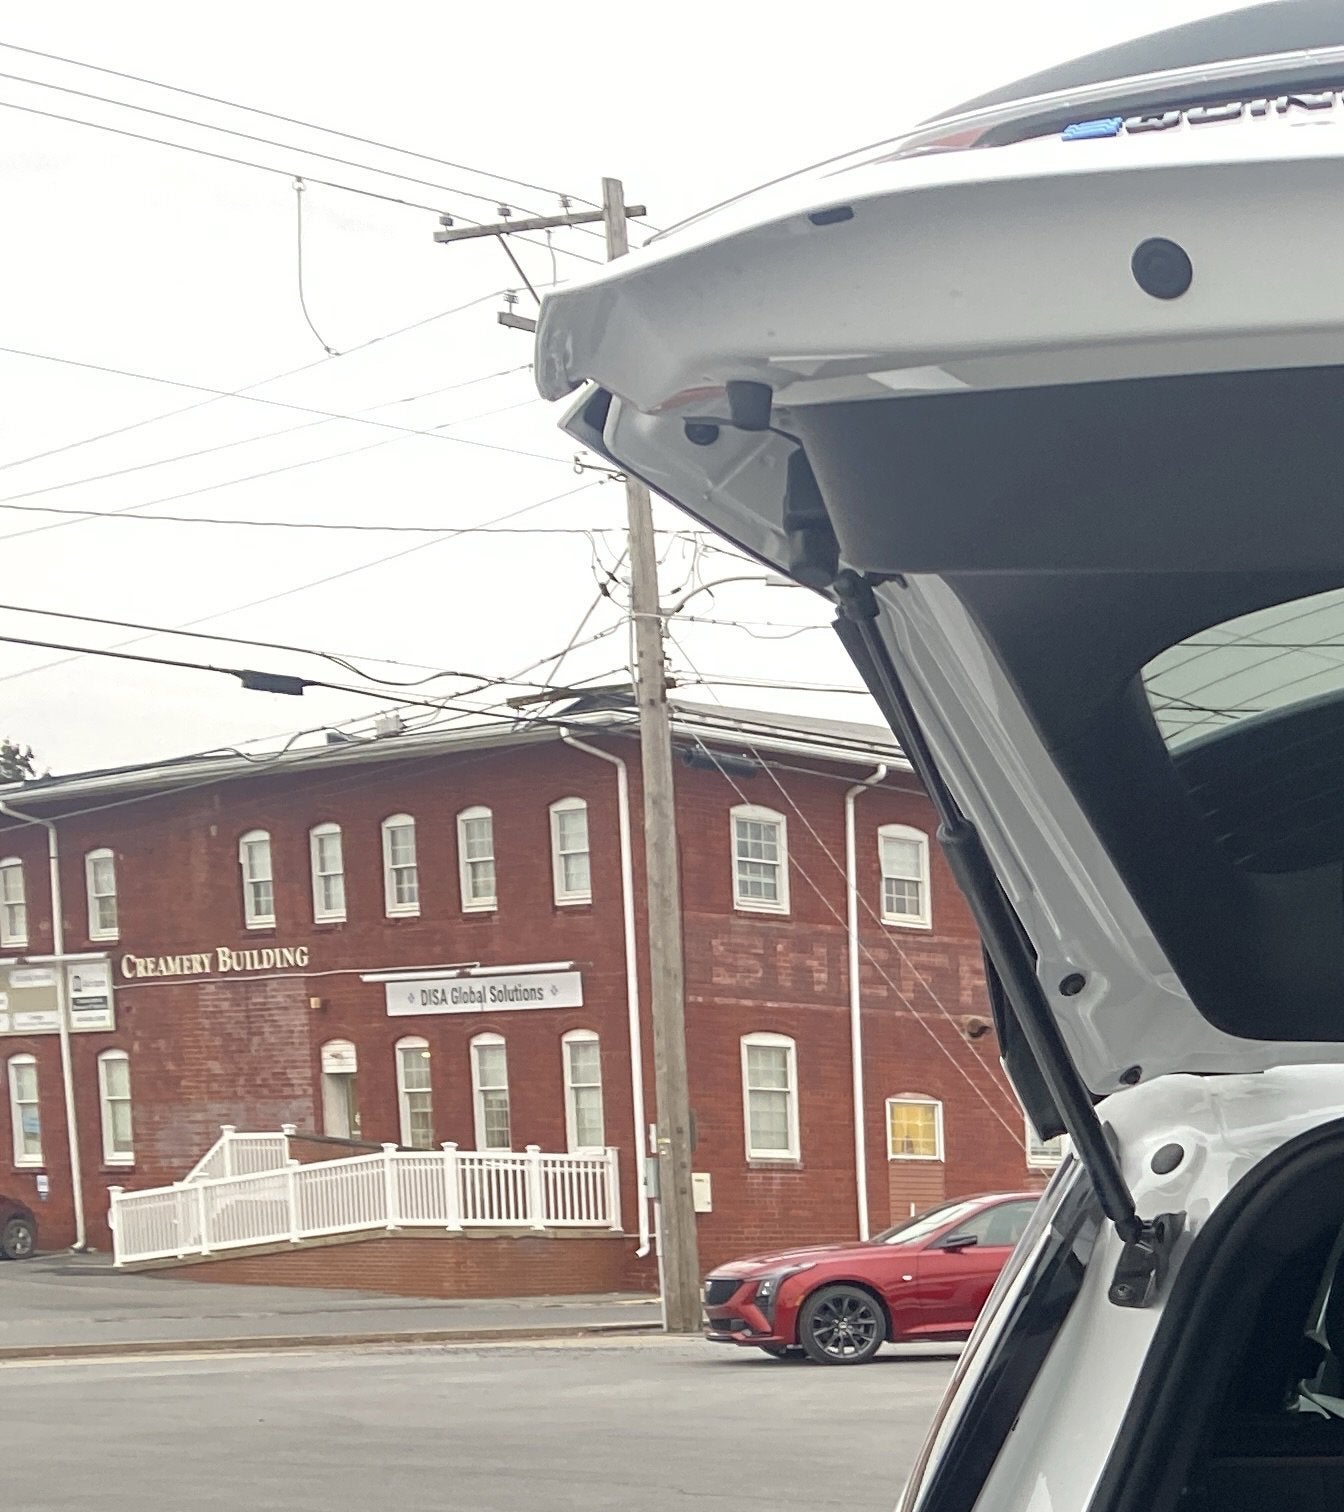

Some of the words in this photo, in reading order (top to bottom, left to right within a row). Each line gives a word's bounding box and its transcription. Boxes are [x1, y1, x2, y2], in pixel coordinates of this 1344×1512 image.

[121, 953, 213, 978] CREAMERY
[216, 947, 310, 972] BUILDING
[420, 988, 448, 1006] DISA
[451, 985, 486, 1004] Global
[489, 984, 544, 1002] Solutions
